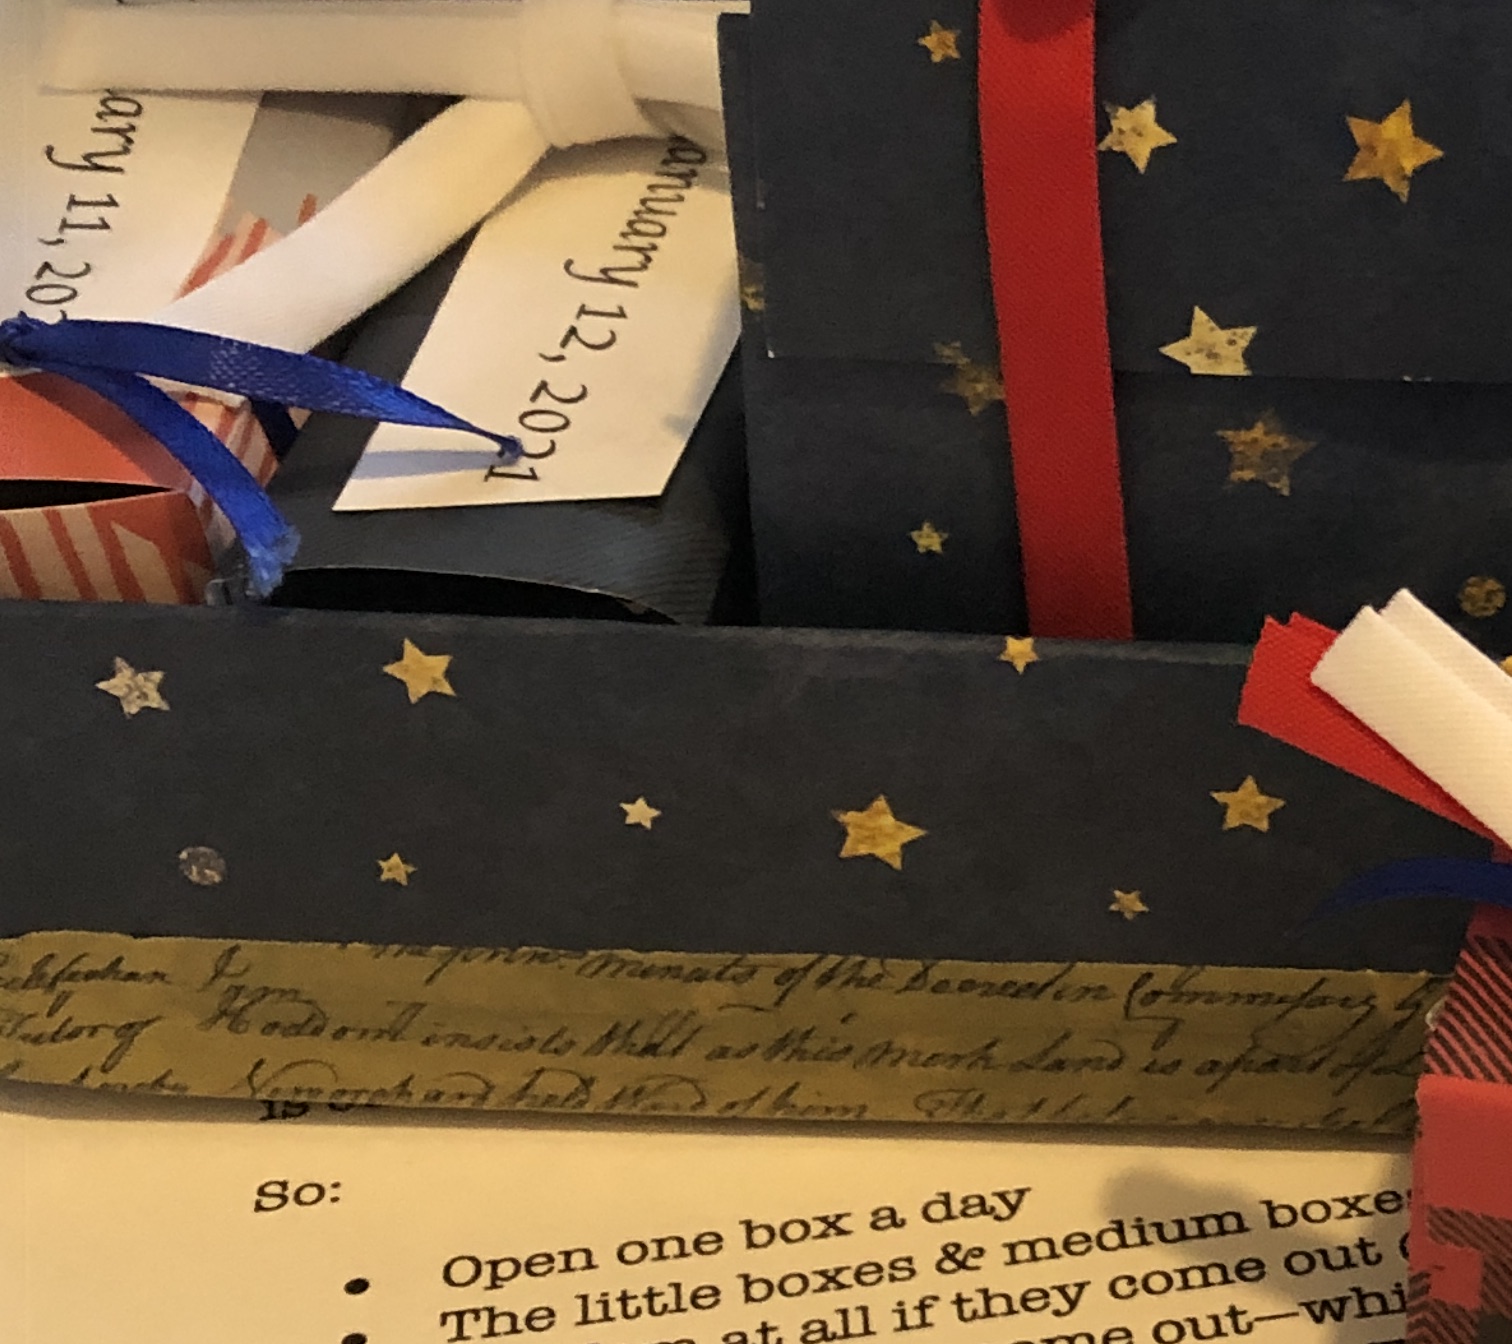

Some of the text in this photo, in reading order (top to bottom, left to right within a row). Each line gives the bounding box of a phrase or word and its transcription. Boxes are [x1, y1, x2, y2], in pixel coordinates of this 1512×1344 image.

[38, 193, 119, 246] 11,
[563, 134, 707, 288] anuary
[25, 261, 91, 320] 20
[538, 304, 628, 363] 12,
[254, 1180, 341, 1213] So:
[439, 1190, 1411, 1344] The little boxes & medium boxe
[442, 1187, 1032, 1291] Open one box a day
[891, 1295, 941, 1333] if
[950, 1280, 1091, 1323] they
[1108, 1257, 1266, 1300] come
[1284, 1237, 1382, 1276] out
